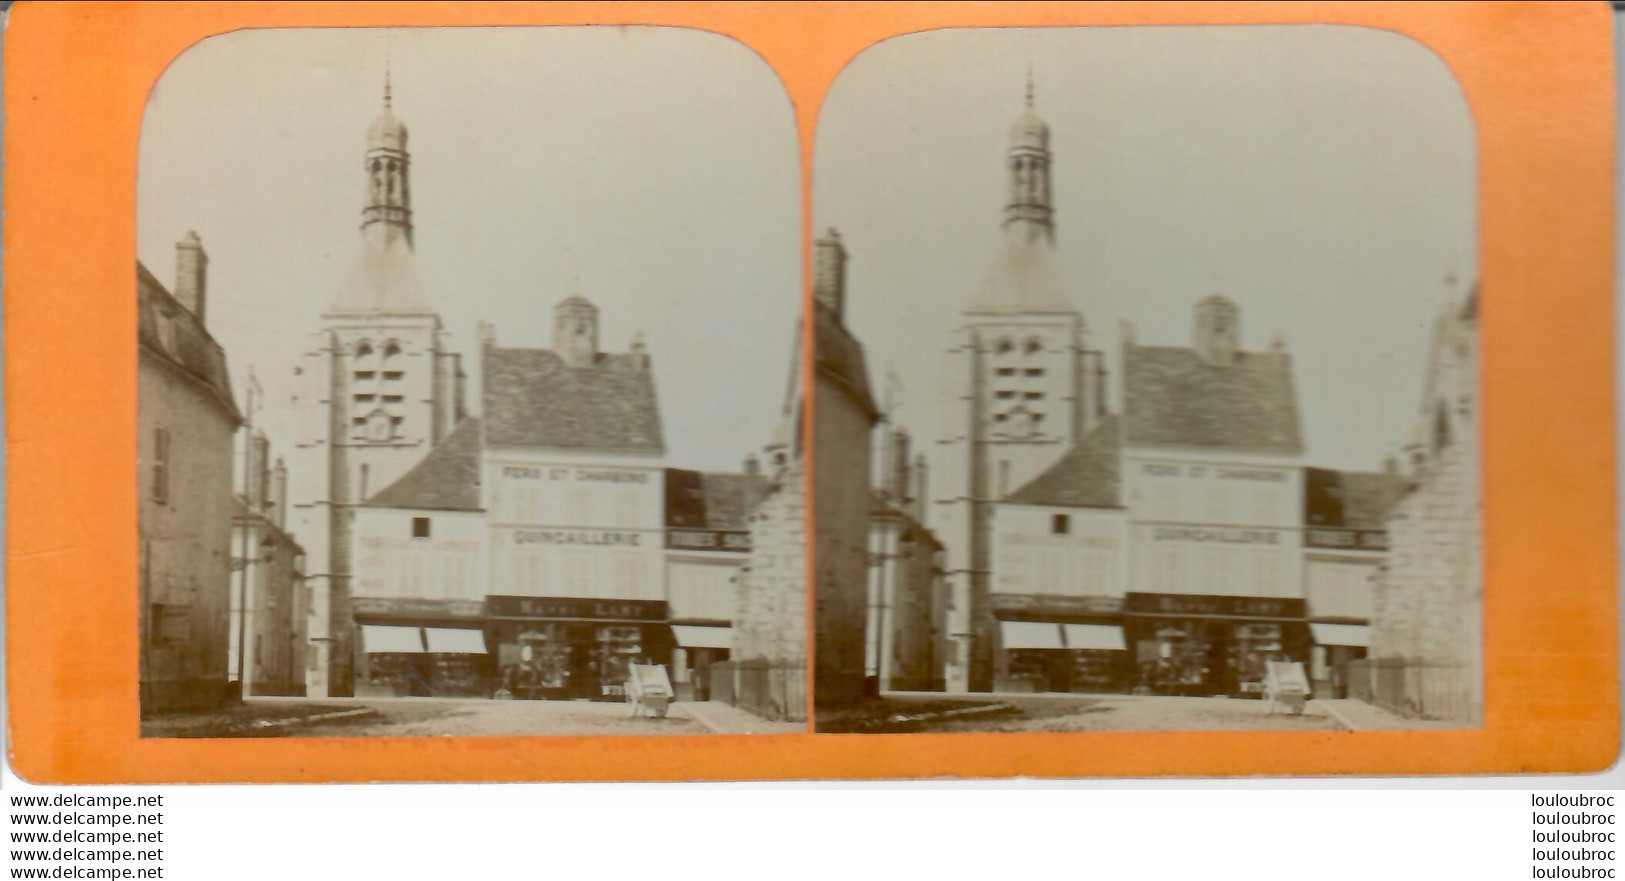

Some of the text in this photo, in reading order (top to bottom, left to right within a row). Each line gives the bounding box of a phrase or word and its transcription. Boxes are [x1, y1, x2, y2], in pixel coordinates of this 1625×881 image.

[549, 468, 569, 480] ET
[514, 530, 641, 547] QUINCAILLERIE
[1154, 527, 1280, 544] QUINCAILLERIE
